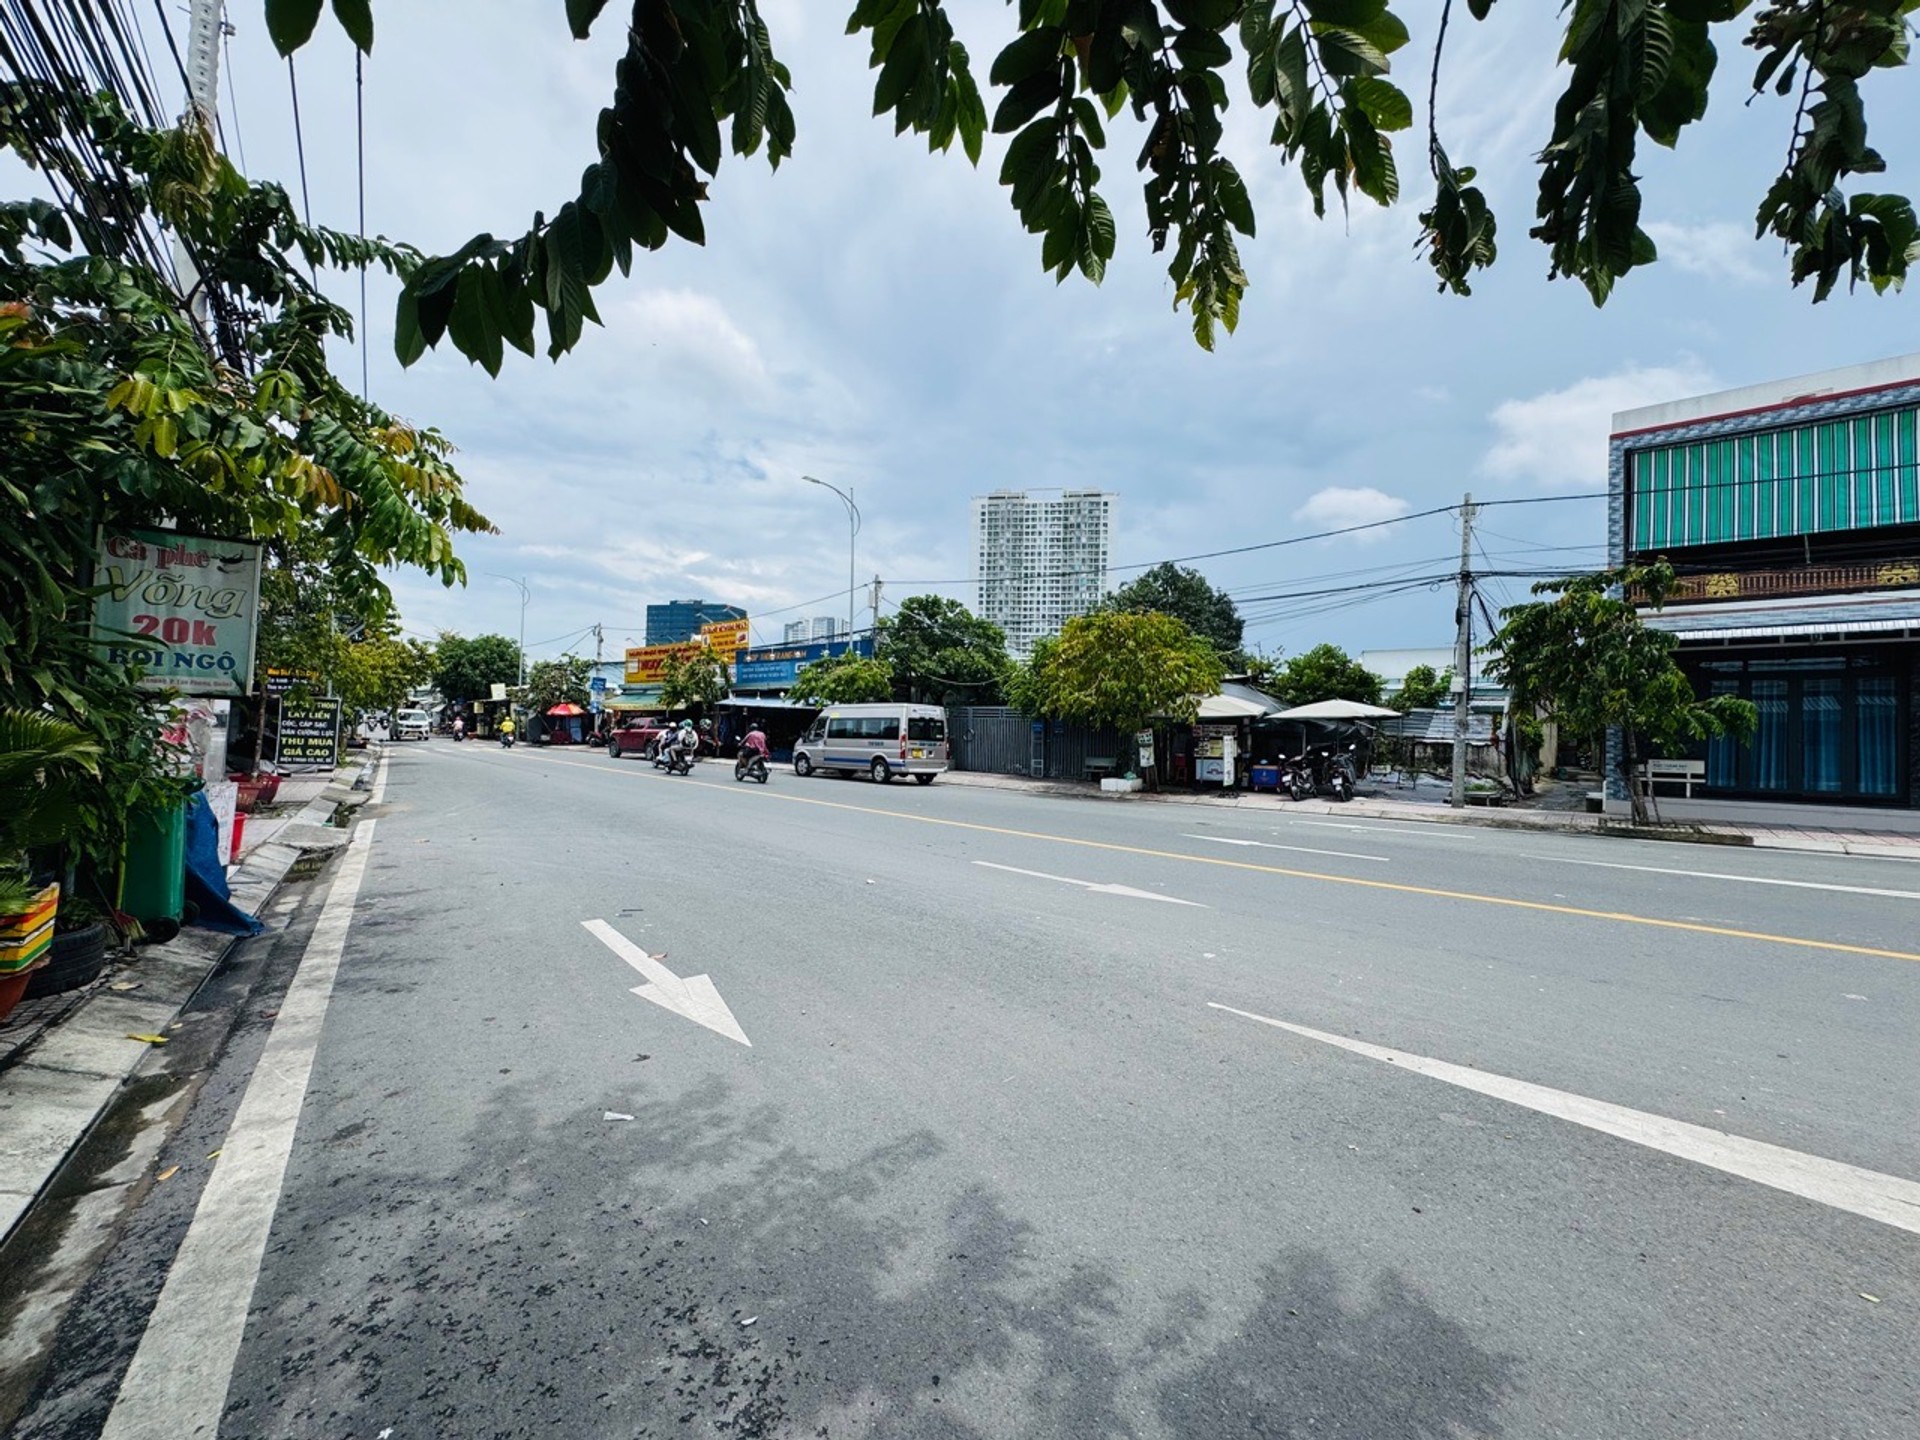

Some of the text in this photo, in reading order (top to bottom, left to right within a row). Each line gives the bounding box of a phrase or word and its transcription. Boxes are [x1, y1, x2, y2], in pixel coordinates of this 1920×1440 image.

[105, 565, 246, 619] Võng
[173, 651, 236, 675] NGỘ
[280, 737, 333, 746] THU MUA
[283, 747, 330, 756] GIÁ CAO
